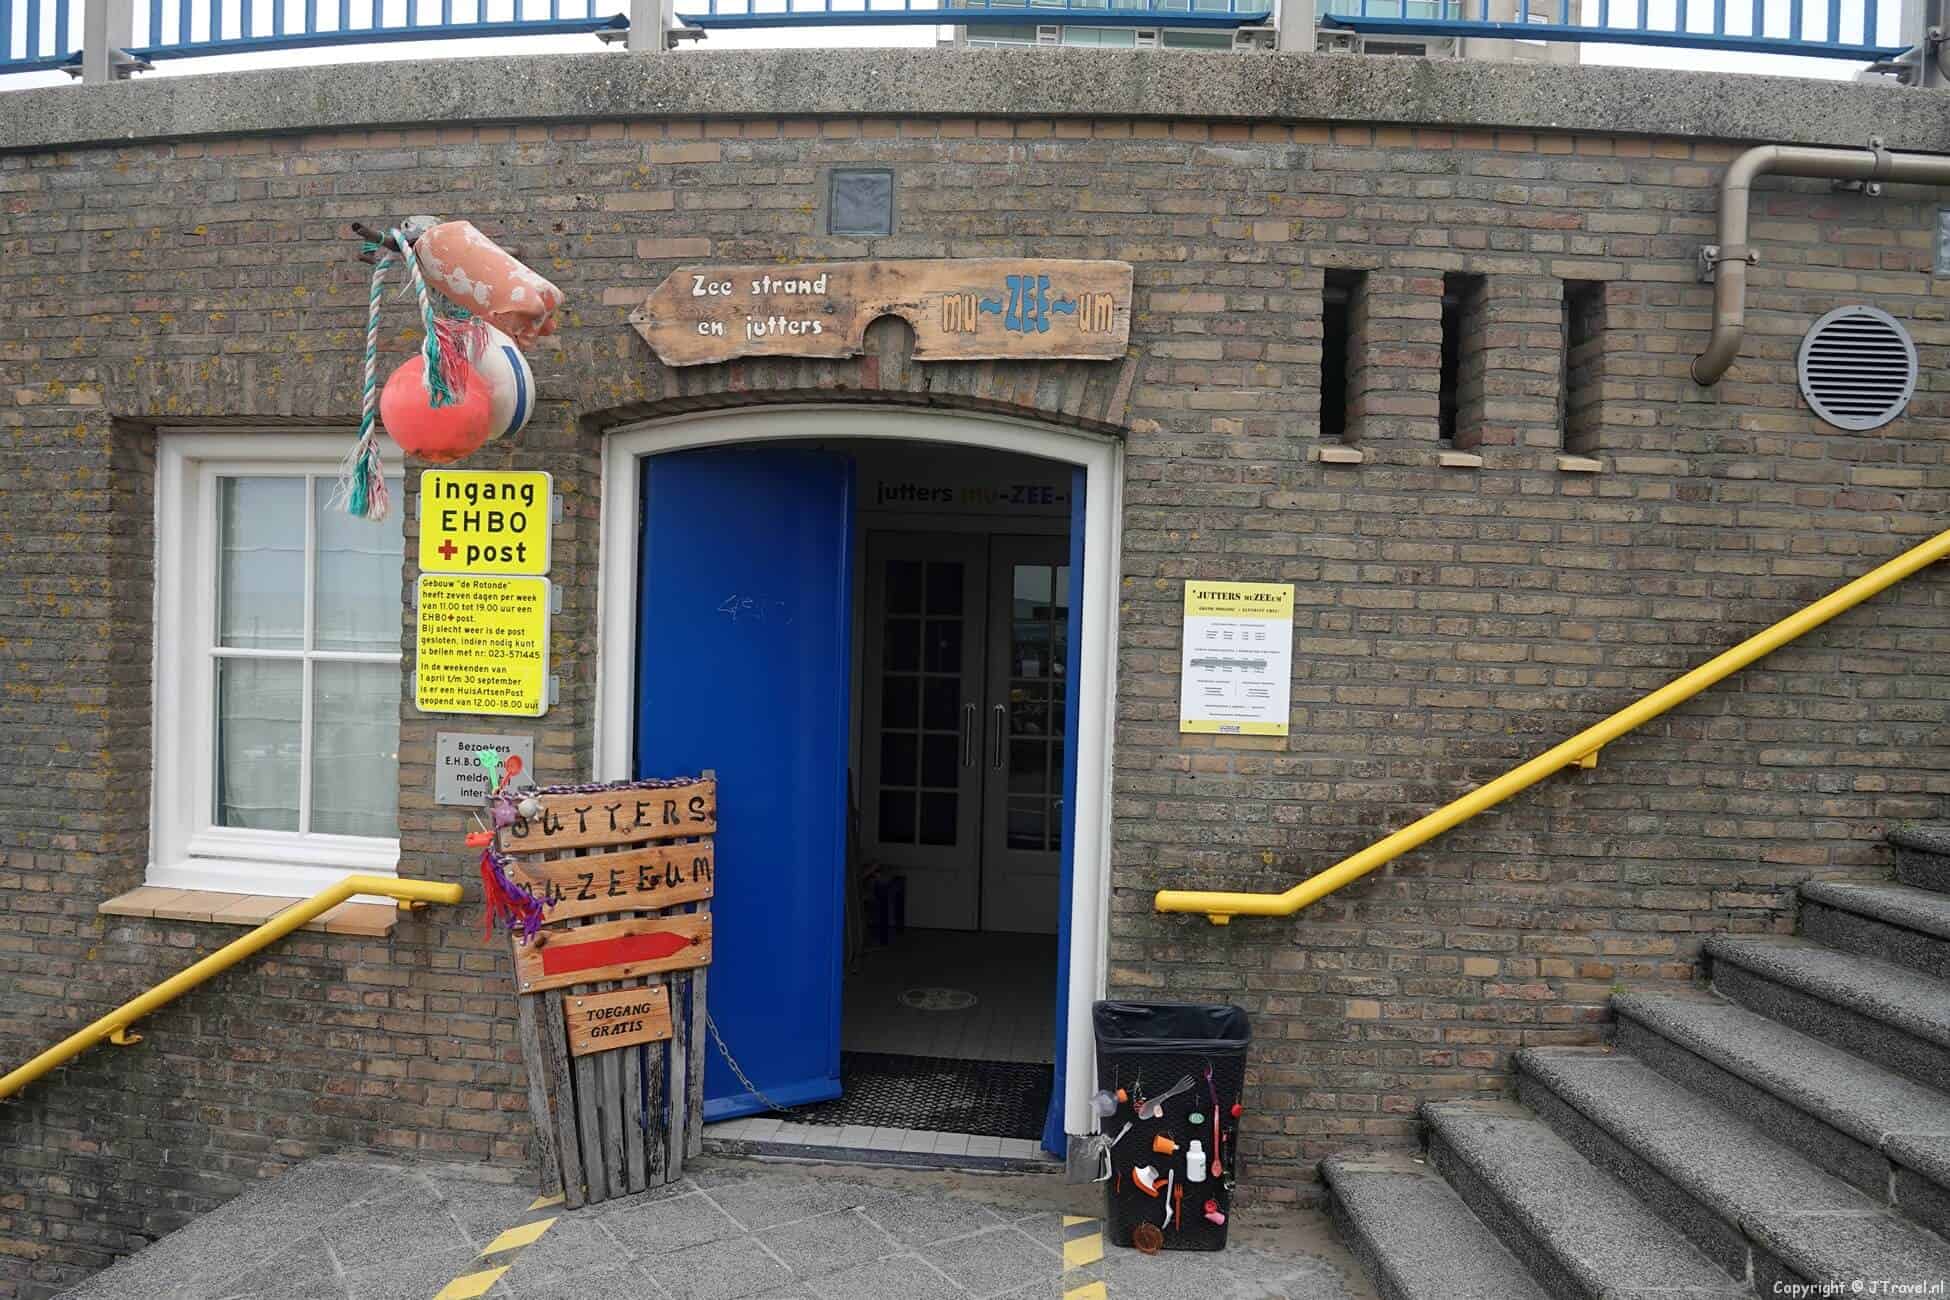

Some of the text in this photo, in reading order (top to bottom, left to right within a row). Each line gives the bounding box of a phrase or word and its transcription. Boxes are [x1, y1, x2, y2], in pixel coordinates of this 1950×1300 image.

[691, 274, 828, 297] Zee strand
[698, 317, 823, 341] en jutters
[435, 477, 534, 507] ingang
[876, 481, 953, 505] jutters
[442, 510, 527, 533] EHBO
[466, 542, 527, 566] post
[423, 579, 454, 588] Gebouw
[422, 591, 536, 603] heeft zeven dagen per week
[1197, 591, 1241, 601] JUTTERS
[439, 602, 460, 610] 11.00
[476, 603, 498, 612] 19.00
[422, 612, 447, 621] EHBO
[422, 624, 434, 634] Bij
[436, 624, 461, 633] slecht
[495, 626, 505, 635] de
[507, 628, 525, 636] post
[490, 638, 512, 648] nodig
[515, 639, 535, 649] kunt
[429, 647, 454, 656] bellen
[431, 663, 441, 671] de
[444, 664, 489, 673] weekenden
[425, 674, 446, 683] april
[447, 675, 463, 683] t/m
[464, 675, 475, 684] 30
[477, 676, 522, 686] september
[457, 687, 523, 697] HuisArtsenPost
[420, 697, 453, 706] geopend
[524, 702, 539, 710] uur
[587, 1002, 651, 1021] TOEGANG
[590, 1020, 644, 1039] GRATIS
